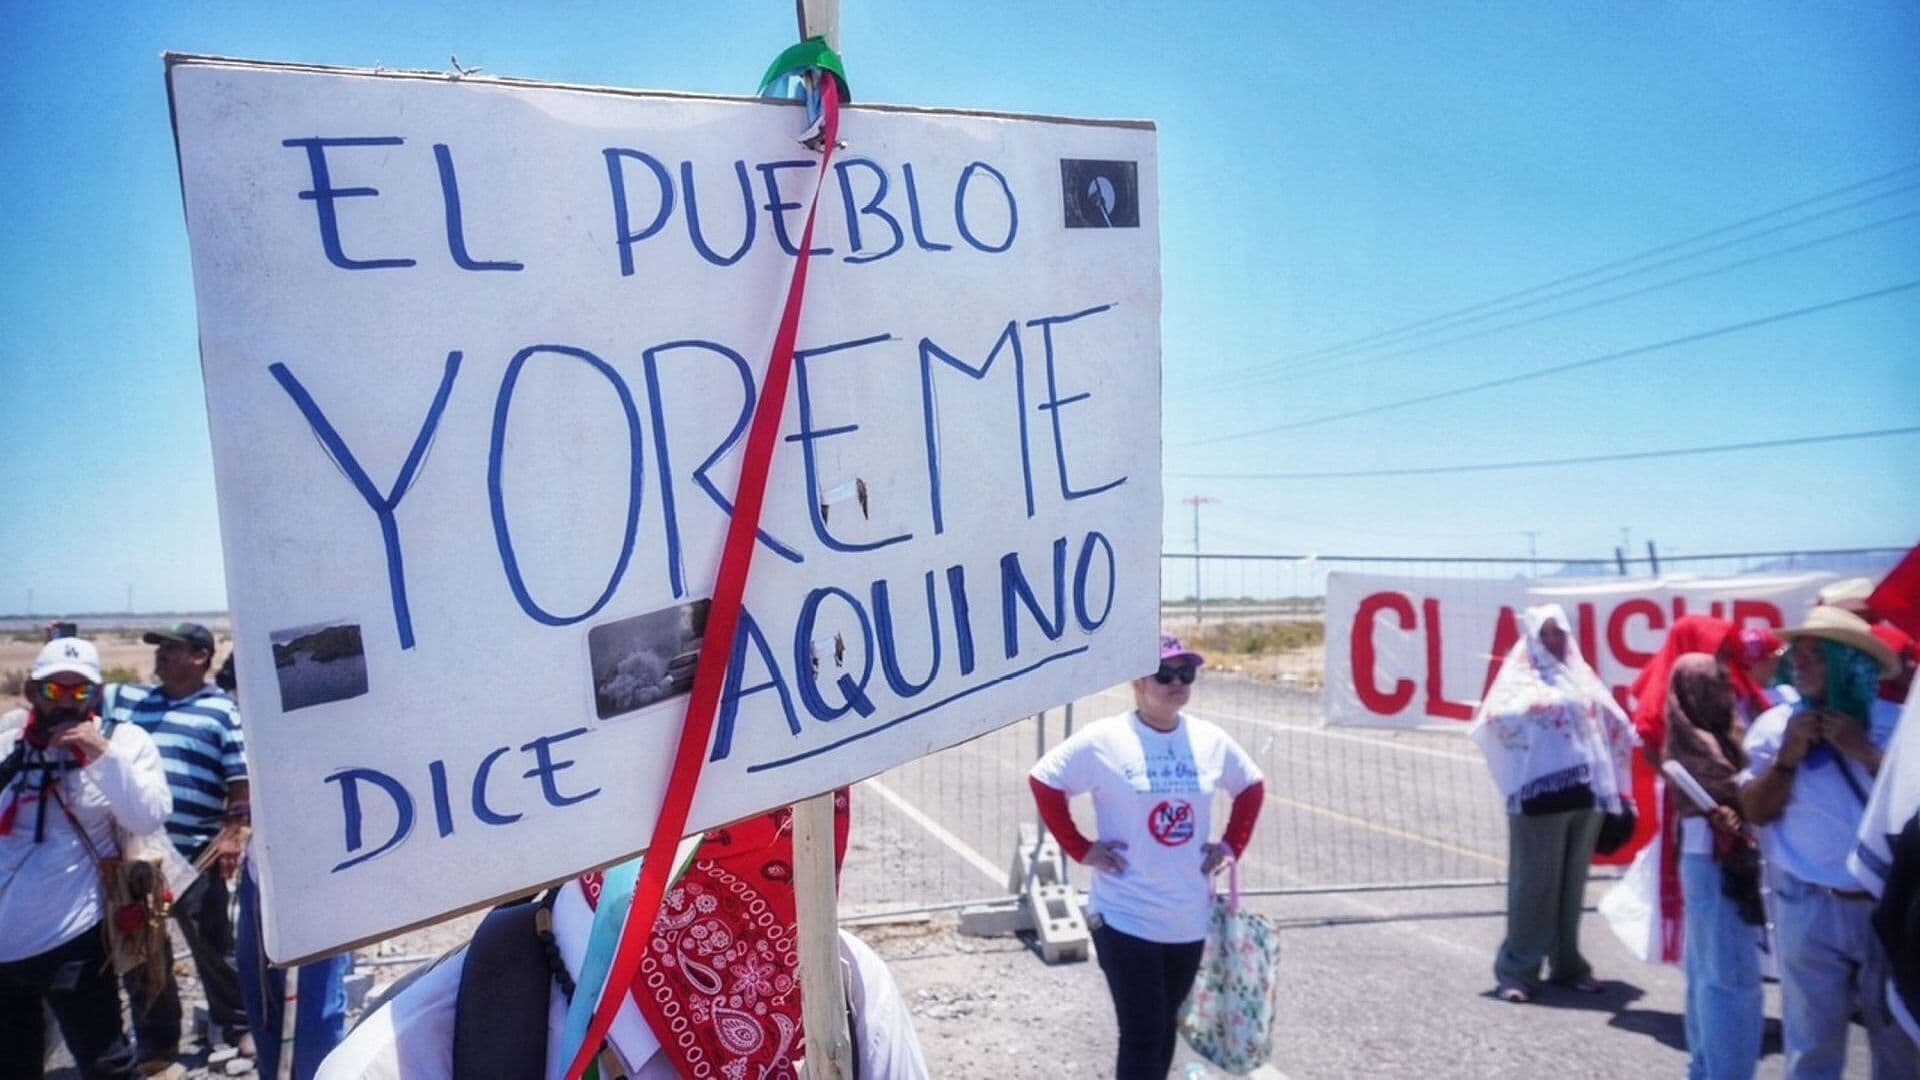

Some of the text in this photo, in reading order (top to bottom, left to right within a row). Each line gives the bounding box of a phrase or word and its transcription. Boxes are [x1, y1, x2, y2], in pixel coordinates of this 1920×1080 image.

[282, 135, 1018, 277] EL PUEBLO
[268, 304, 1127, 651] YOREME
[324, 728, 601, 873] DICE
